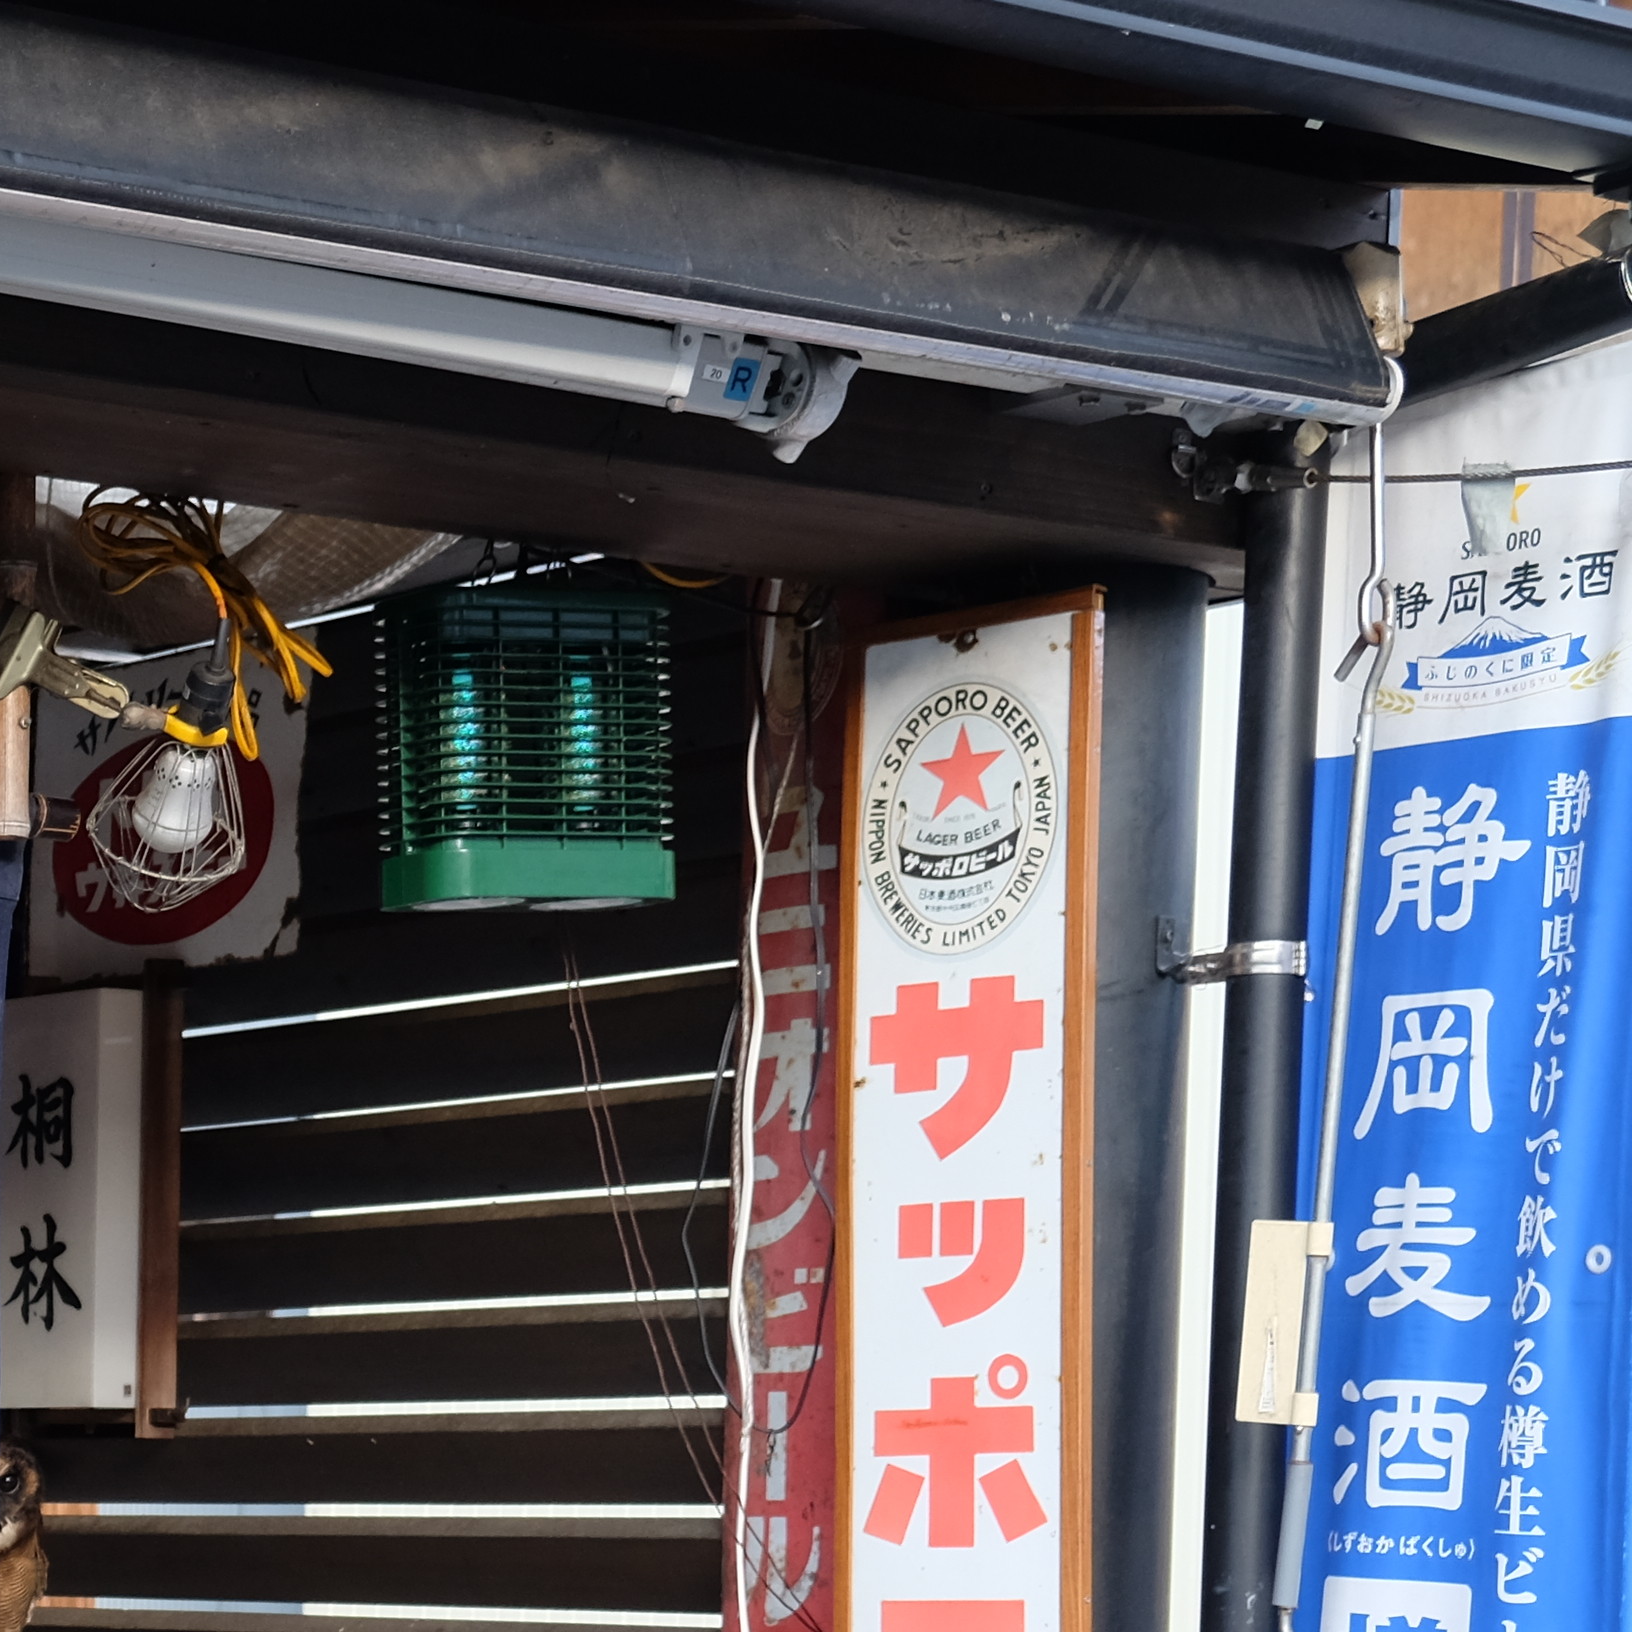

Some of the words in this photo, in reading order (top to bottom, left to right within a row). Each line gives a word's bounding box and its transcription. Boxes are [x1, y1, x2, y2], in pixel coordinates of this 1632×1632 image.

[729, 366, 753, 393] R
[1461, 527, 1542, 560] SORO
[1393, 549, 1619, 631] 静岡麦酒
[1423, 690, 1487, 703] SHIZUOKA
[1494, 674, 1558, 697] BAKUSYU
[1424, 647, 1558, 681] ふじのくに限定
[883, 689, 988, 775] SAPPORO
[990, 696, 1040, 753] BEER
[867, 797, 889, 865] NIPPON
[1033, 773, 1052, 836] JAPAN
[902, 840, 1014, 877] サッポロビール
[916, 828, 959, 847] LAGER
[964, 819, 1002, 841] BEER
[1005, 847, 1045, 903] TOKYO
[874, 871, 933, 945] BREWERIES
[941, 907, 1007, 947] LIMITED
[1333, 783, 1532, 1511] 静岡麦酒
[3, 1073, 83, 1333] 桐林
